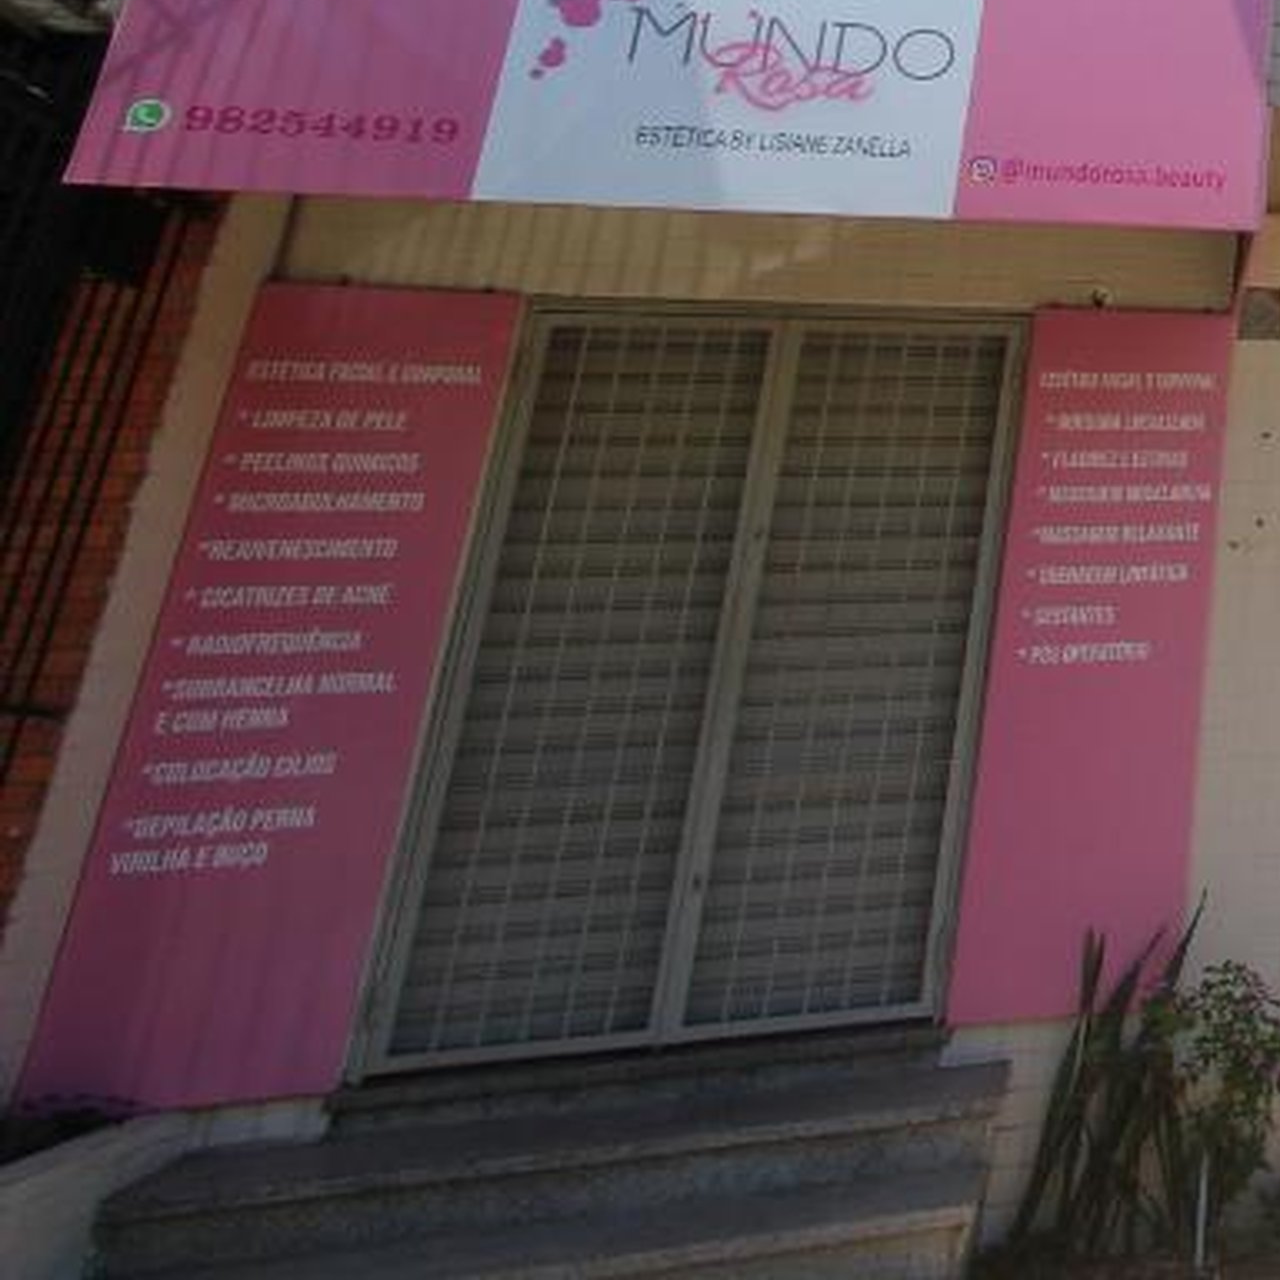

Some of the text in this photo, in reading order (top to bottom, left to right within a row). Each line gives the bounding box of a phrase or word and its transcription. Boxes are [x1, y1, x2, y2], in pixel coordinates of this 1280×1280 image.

[628, 6, 955, 81] MUNDO
[704, 42, 876, 111] Rosa
[185, 104, 460, 145] 982544919
[830, 135, 911, 159] ZANELLA
